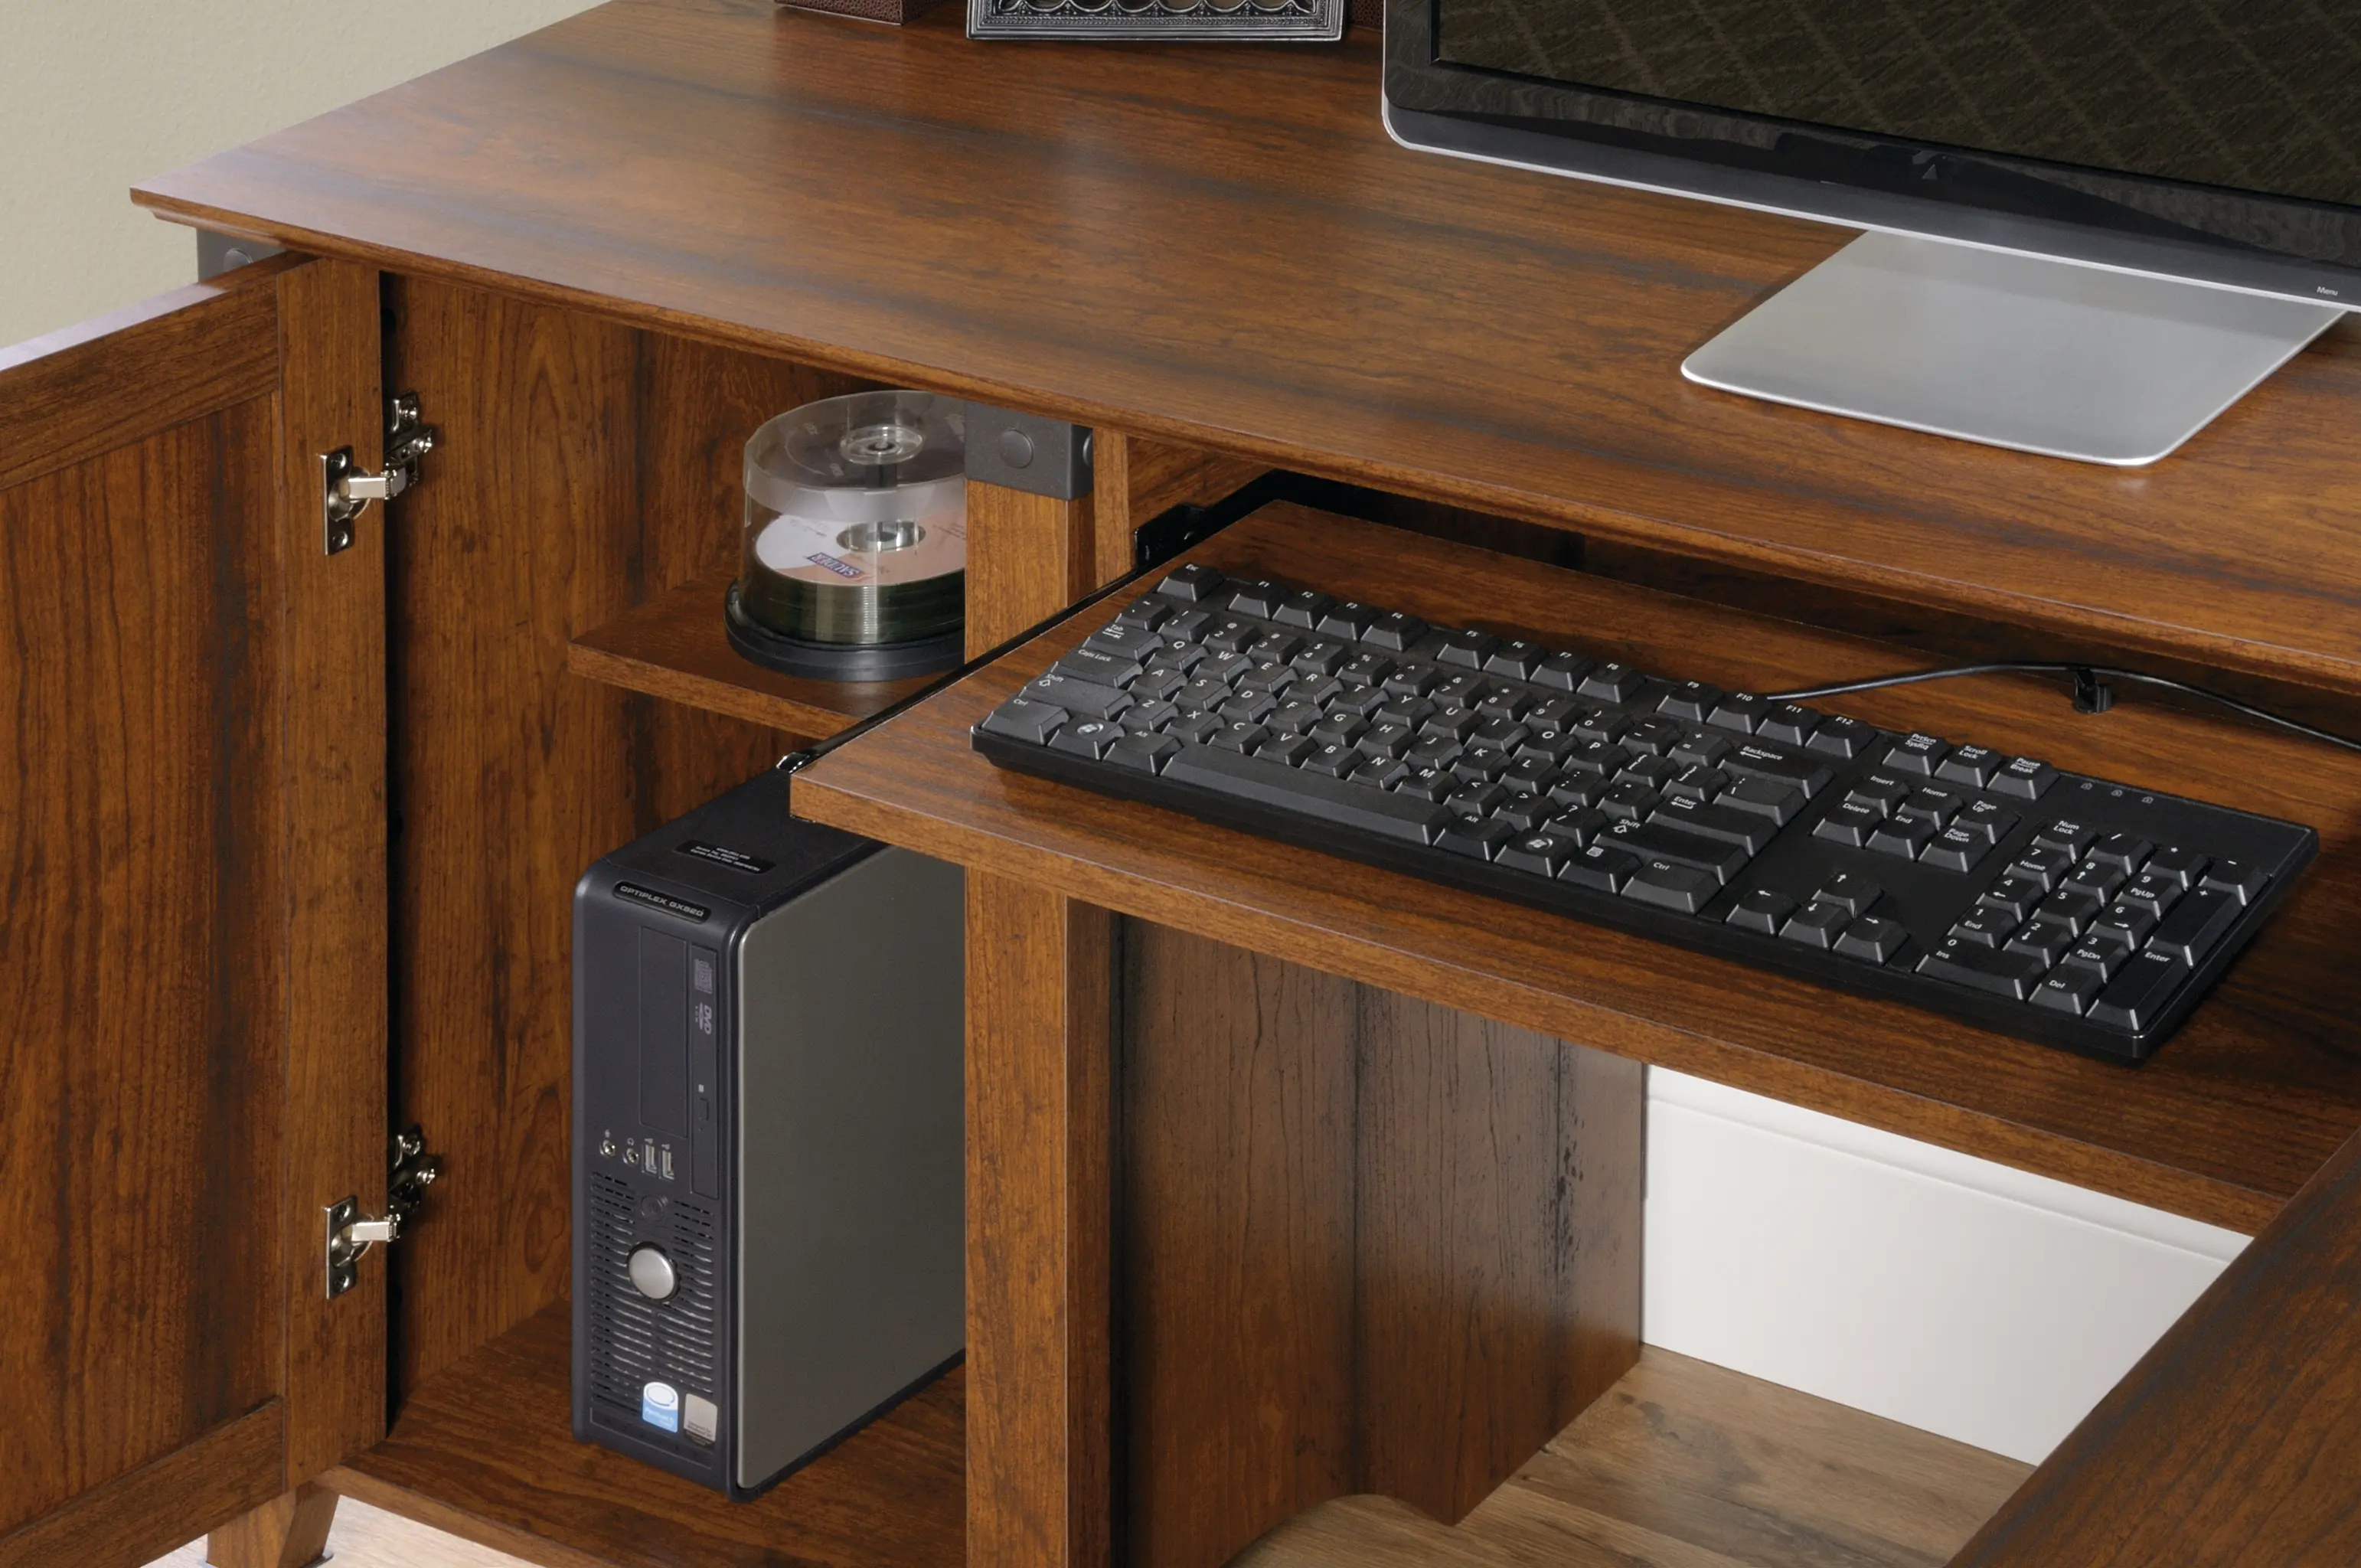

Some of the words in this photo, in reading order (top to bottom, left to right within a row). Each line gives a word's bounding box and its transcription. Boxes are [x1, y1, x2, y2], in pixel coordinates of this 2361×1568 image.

[1173, 641, 1185, 649] Q
[1078, 648, 1095, 658] Caps
[1095, 653, 1112, 662] Lock
[1218, 651, 1235, 661] W
[1260, 662, 1273, 671] E
[1606, 662, 1619, 671] F8
[1151, 668, 1164, 677] A
[1305, 673, 1318, 682] R
[1047, 673, 1064, 683] Shift
[1354, 684, 1366, 692] T
[1687, 681, 1700, 689] F9
[1240, 690, 1253, 698] D
[1400, 694, 1413, 704] Y
[1736, 692, 1753, 702] F10
[1141, 699, 1155, 708] Z
[1286, 701, 1298, 709] F
[1445, 707, 1458, 716] U
[1785, 704, 1802, 714] F11
[1187, 710, 1201, 720] X
[1334, 714, 1347, 722] G
[1233, 722, 1246, 730] C
[1835, 716, 1854, 726] F12
[1379, 724, 1393, 733] H
[1279, 732, 1293, 742] V
[1542, 730, 1555, 740] O
[1911, 733, 1937, 744] PrtScn
[1425, 737, 1438, 745] J
[1589, 741, 1602, 750] P
[1904, 739, 1930, 751] SysRq
[1324, 745, 1337, 754] B
[1474, 747, 1488, 757] K
[1742, 746, 1783, 761] Backspace
[1963, 745, 1988, 755] Scroll
[1958, 750, 1978, 760] Lock
[1370, 756, 1386, 766] N
[1522, 759, 1531, 768] L
[2016, 756, 2041, 768] Pause
[1419, 768, 1436, 778] M
[2010, 763, 2035, 774] Break
[1870, 775, 1895, 786] Insert
[1922, 786, 1948, 798] Home
[1673, 795, 1697, 806] Enter
[1842, 802, 1870, 814] Delete
[1971, 804, 1986, 813] Up
[1976, 800, 1997, 812] Page
[1464, 815, 1479, 823] Alt
[1618, 818, 1641, 829] Shift
[1895, 815, 1913, 824] End
[2052, 825, 2074, 835] Lock
[2059, 820, 2080, 831] Num
[1943, 832, 1970, 843] Down
[1948, 828, 1970, 838] Page
[2030, 848, 2042, 856] 7
[1653, 861, 1670, 871] Ctrl
[2020, 860, 2046, 871] Home
[2085, 861, 2096, 870] 8
[2141, 875, 2152, 884] 9
[619, 885, 668, 905] OPTIPLEX
[2057, 891, 2069, 900] 5
[2130, 887, 2155, 899] PgUp
[1976, 908, 1984, 916] 1
[2114, 906, 2125, 914] 6
[1964, 920, 1983, 930] End
[2030, 922, 2043, 931] 2
[1947, 939, 1958, 947] 0
[2087, 936, 2098, 946] 3
[1935, 950, 1951, 959] Ins
[2076, 949, 2101, 960] PgDn
[2144, 951, 2170, 962] Enter
[2048, 979, 2066, 989] Del
[703, 1004, 712, 1035] DVD
